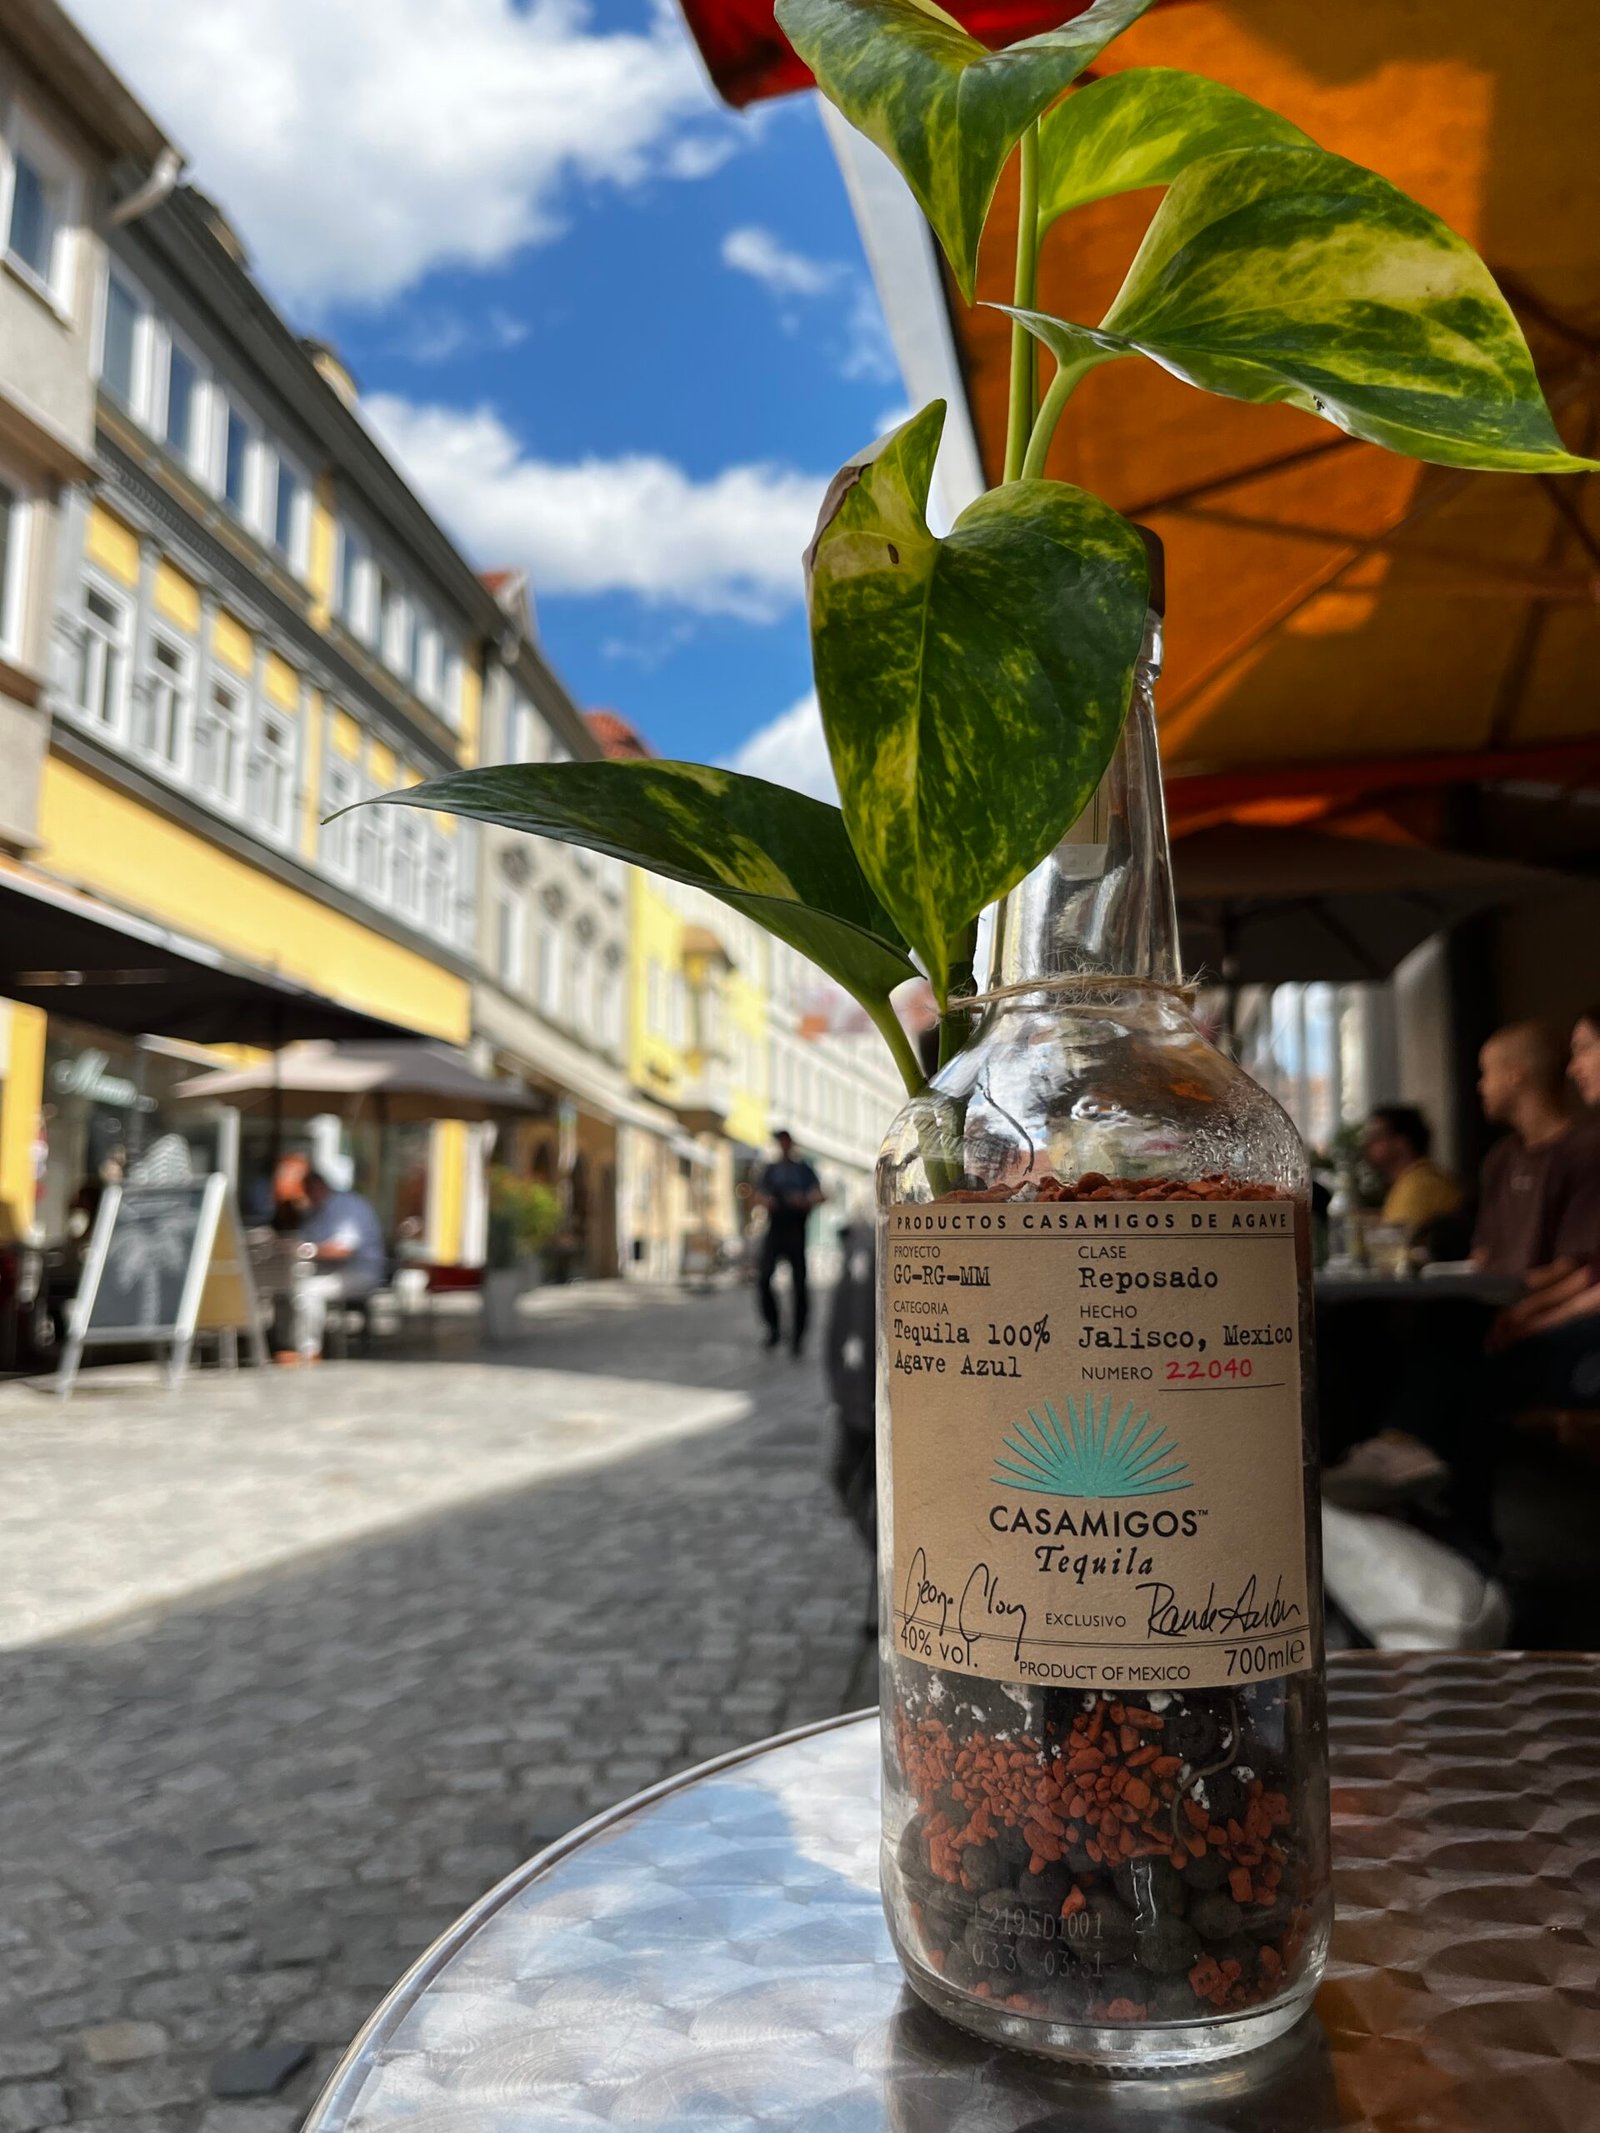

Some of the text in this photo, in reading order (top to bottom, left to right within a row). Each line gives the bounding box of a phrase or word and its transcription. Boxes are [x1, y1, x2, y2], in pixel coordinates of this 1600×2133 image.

[896, 1213, 1287, 1230] PRODUCTOS CASAMIGOS DE AGAVE
[894, 1245, 941, 1259] PROYECTO
[1078, 1245, 1127, 1260] CLASE
[1078, 1266, 1219, 1294] Reposado
[893, 1300, 949, 1315] CATEGORIA
[1079, 1305, 1138, 1319] HECHO
[893, 1314, 1051, 1352] Tequila 100%
[1078, 1325, 1293, 1352] Jalisco, Mexico
[894, 1350, 1022, 1378] Agave Azul
[1081, 1359, 1253, 1381] NUMERO 22040
[1035, 1545, 1153, 1585] Tequila
[1045, 1613, 1127, 1628] EXCLUSIVO
[900, 1625, 932, 1657] 40%
[1019, 1660, 1191, 1681] PRODUCT OF MEXICO
